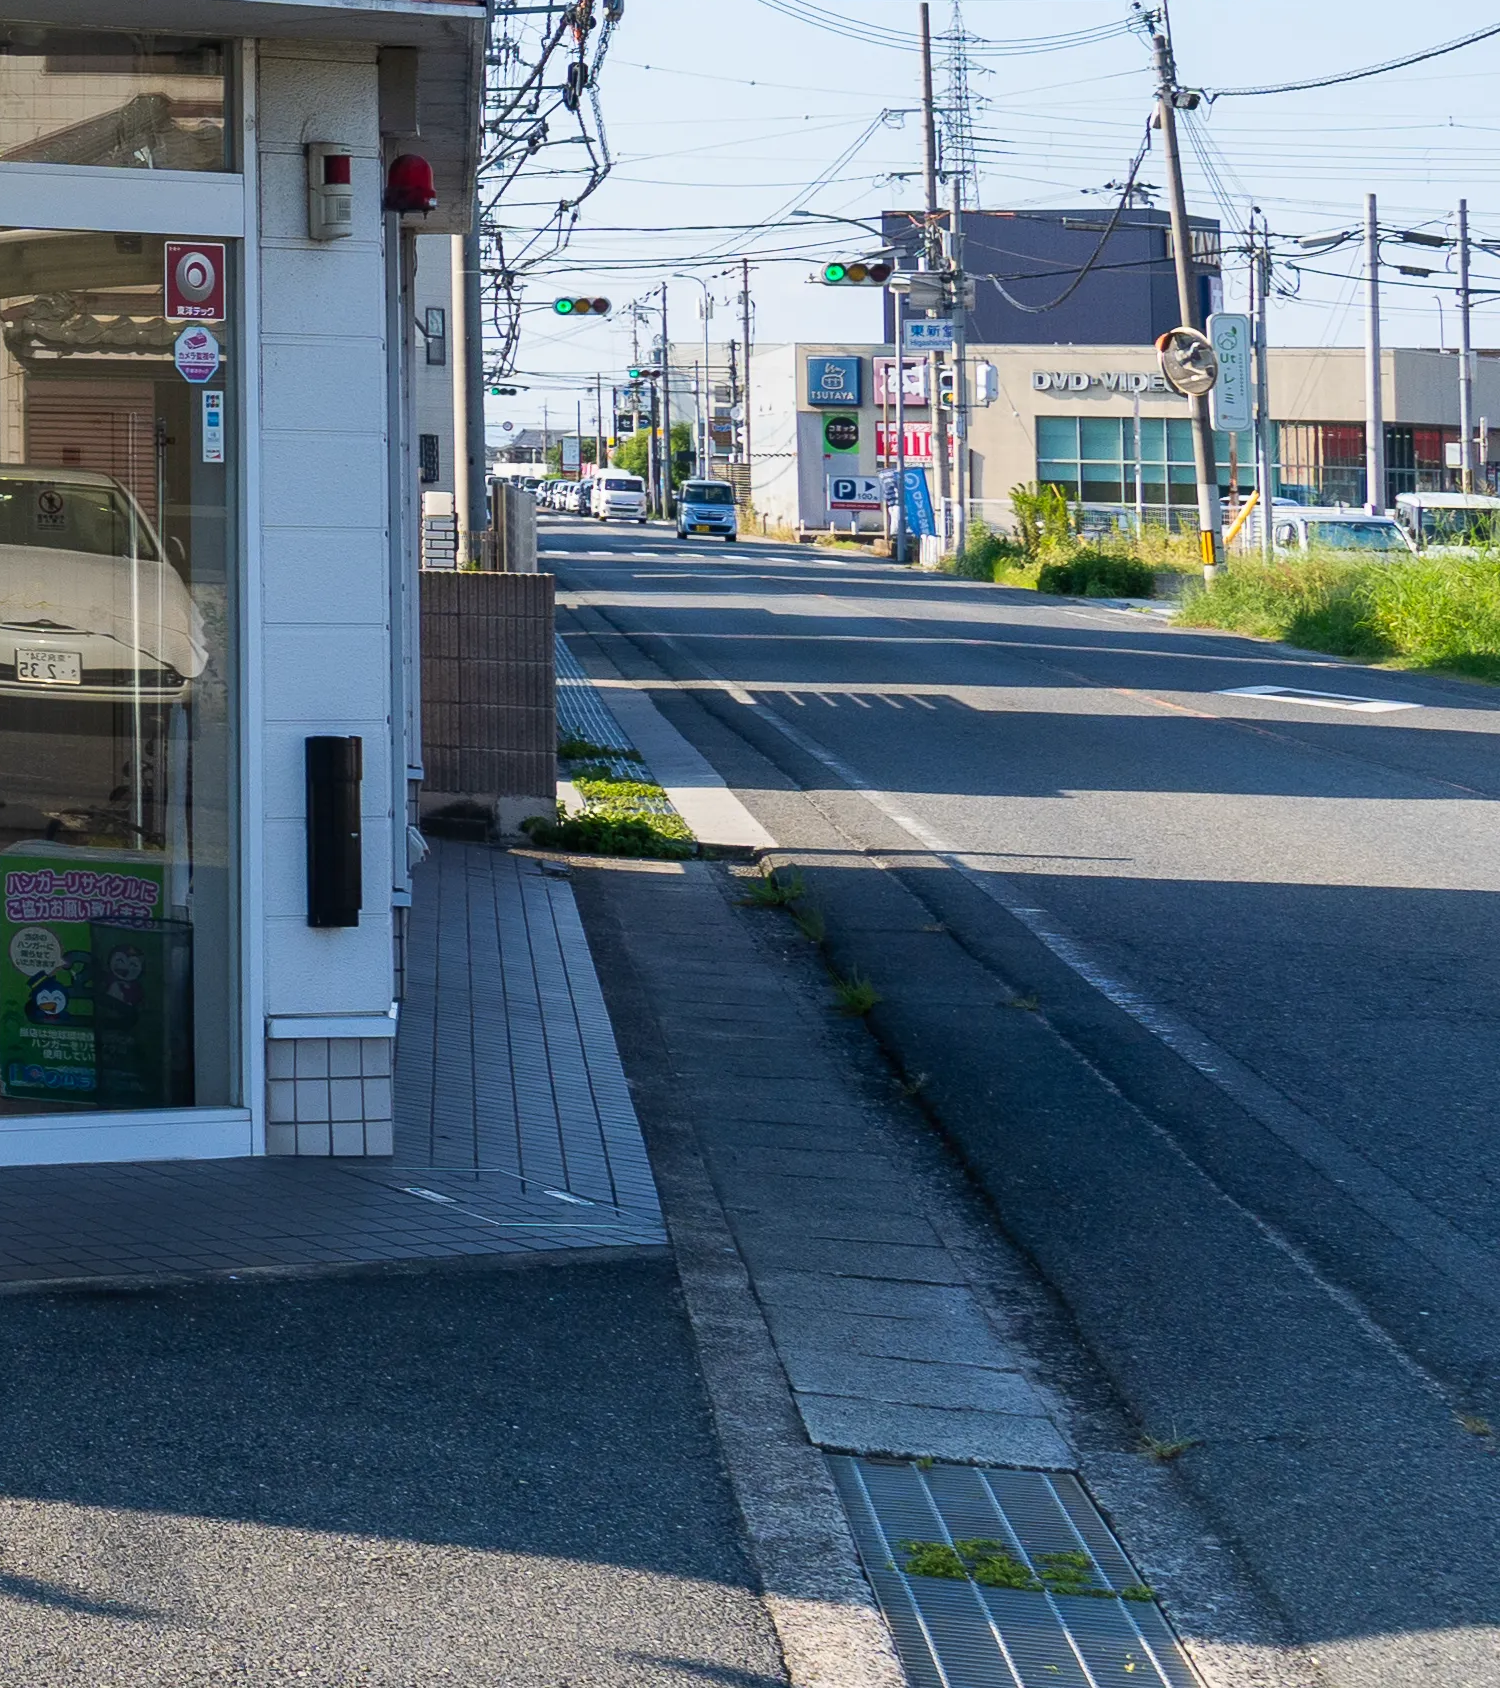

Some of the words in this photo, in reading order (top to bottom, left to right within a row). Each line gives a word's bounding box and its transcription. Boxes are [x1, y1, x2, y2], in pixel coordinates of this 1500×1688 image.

[811, 391, 854, 400] TSUTAYA
[7, 870, 159, 905] ハンガーリサイクルに
